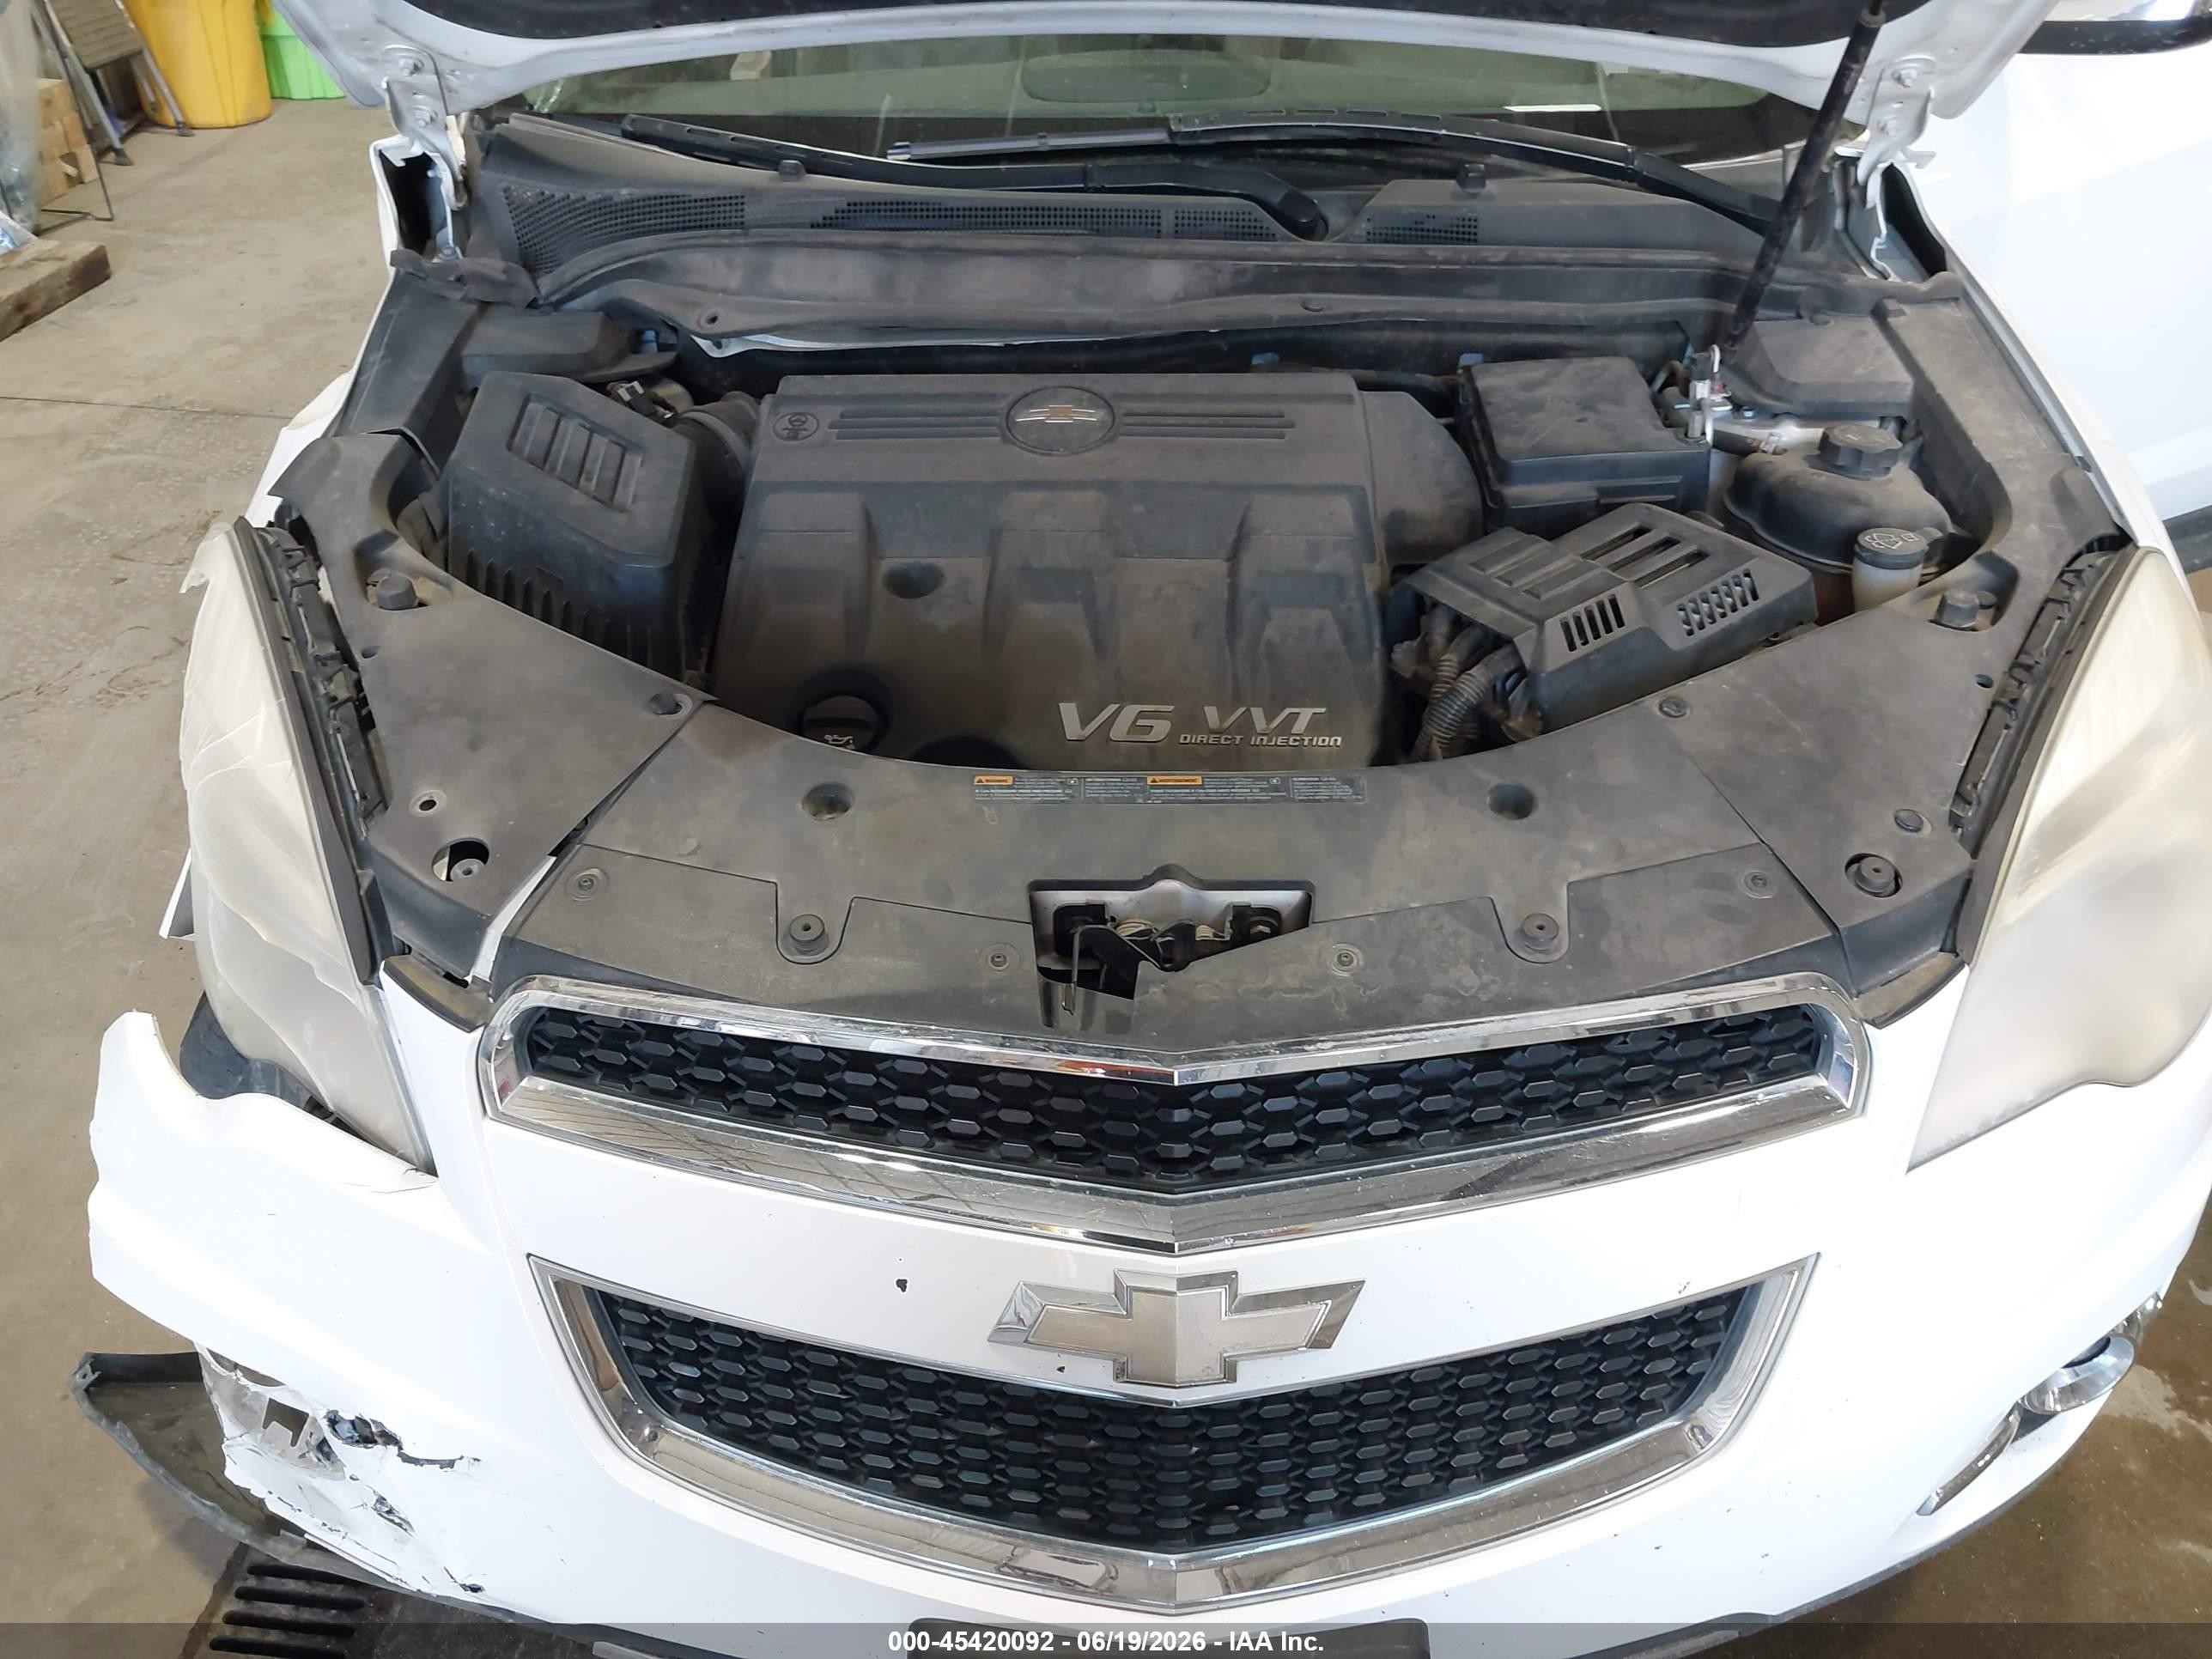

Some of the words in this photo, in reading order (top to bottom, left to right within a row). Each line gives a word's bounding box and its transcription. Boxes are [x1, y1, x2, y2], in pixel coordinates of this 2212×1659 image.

[1058, 702, 1176, 743] V6
[1203, 705, 1327, 734] VVT
[1179, 733, 1244, 746] DIRECT
[1250, 735, 1342, 748] INJECTION
